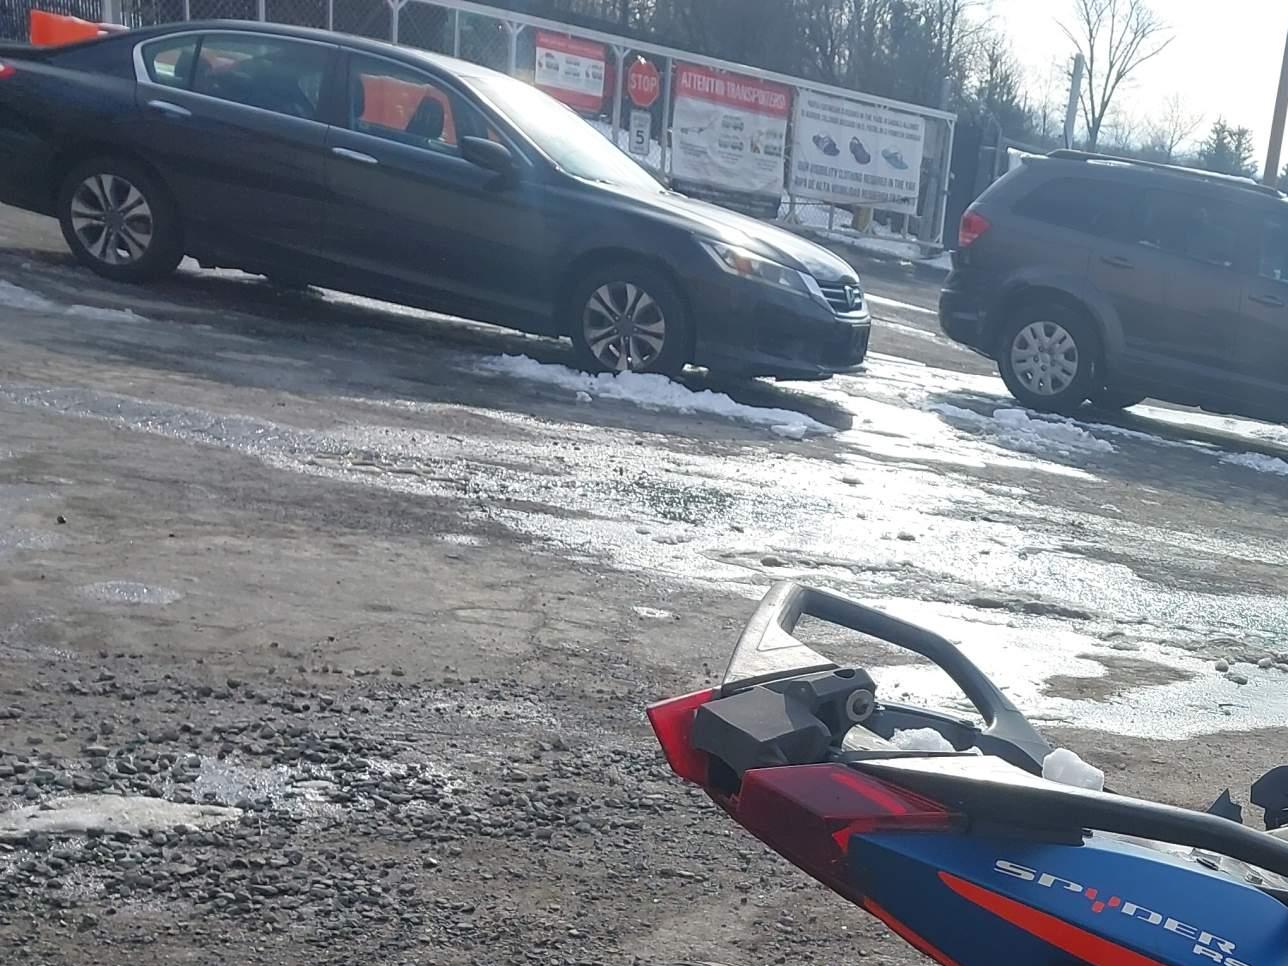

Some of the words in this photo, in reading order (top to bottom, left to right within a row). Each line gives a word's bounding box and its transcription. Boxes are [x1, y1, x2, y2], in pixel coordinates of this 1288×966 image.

[631, 73, 657, 93] STOP
[636, 130, 645, 145] 5
[993, 859, 1236, 955] SPYDER
